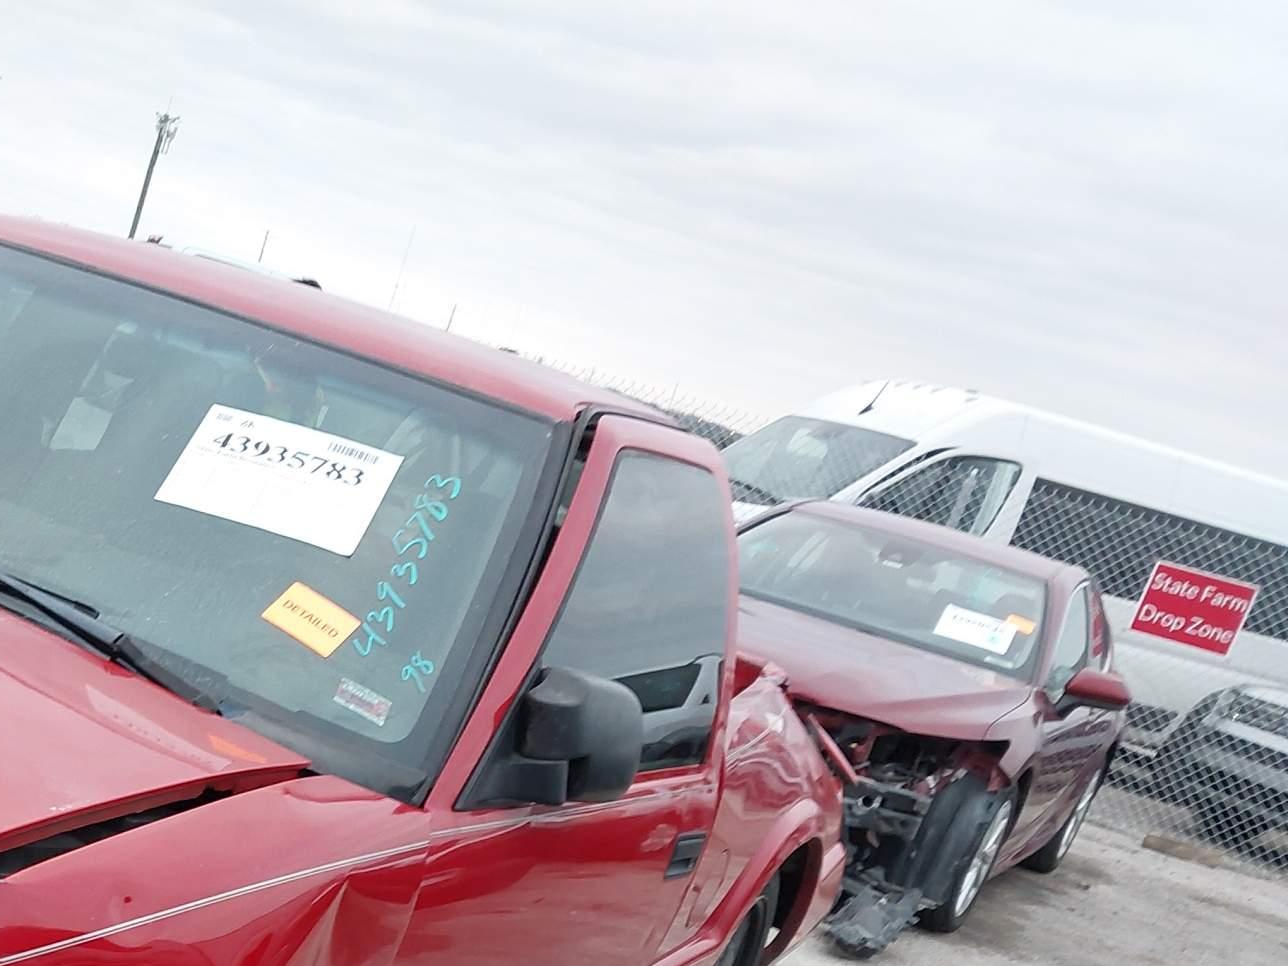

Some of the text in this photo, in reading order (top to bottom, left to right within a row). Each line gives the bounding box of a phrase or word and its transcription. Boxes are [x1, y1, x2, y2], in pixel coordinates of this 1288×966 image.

[212, 432, 366, 487] 43935783
[351, 473, 462, 657] 43935783
[1150, 572, 1249, 614] State Farm
[281, 599, 340, 639] DETAILED
[1138, 603, 1234, 645] Drop Zone
[400, 650, 435, 694] 98
